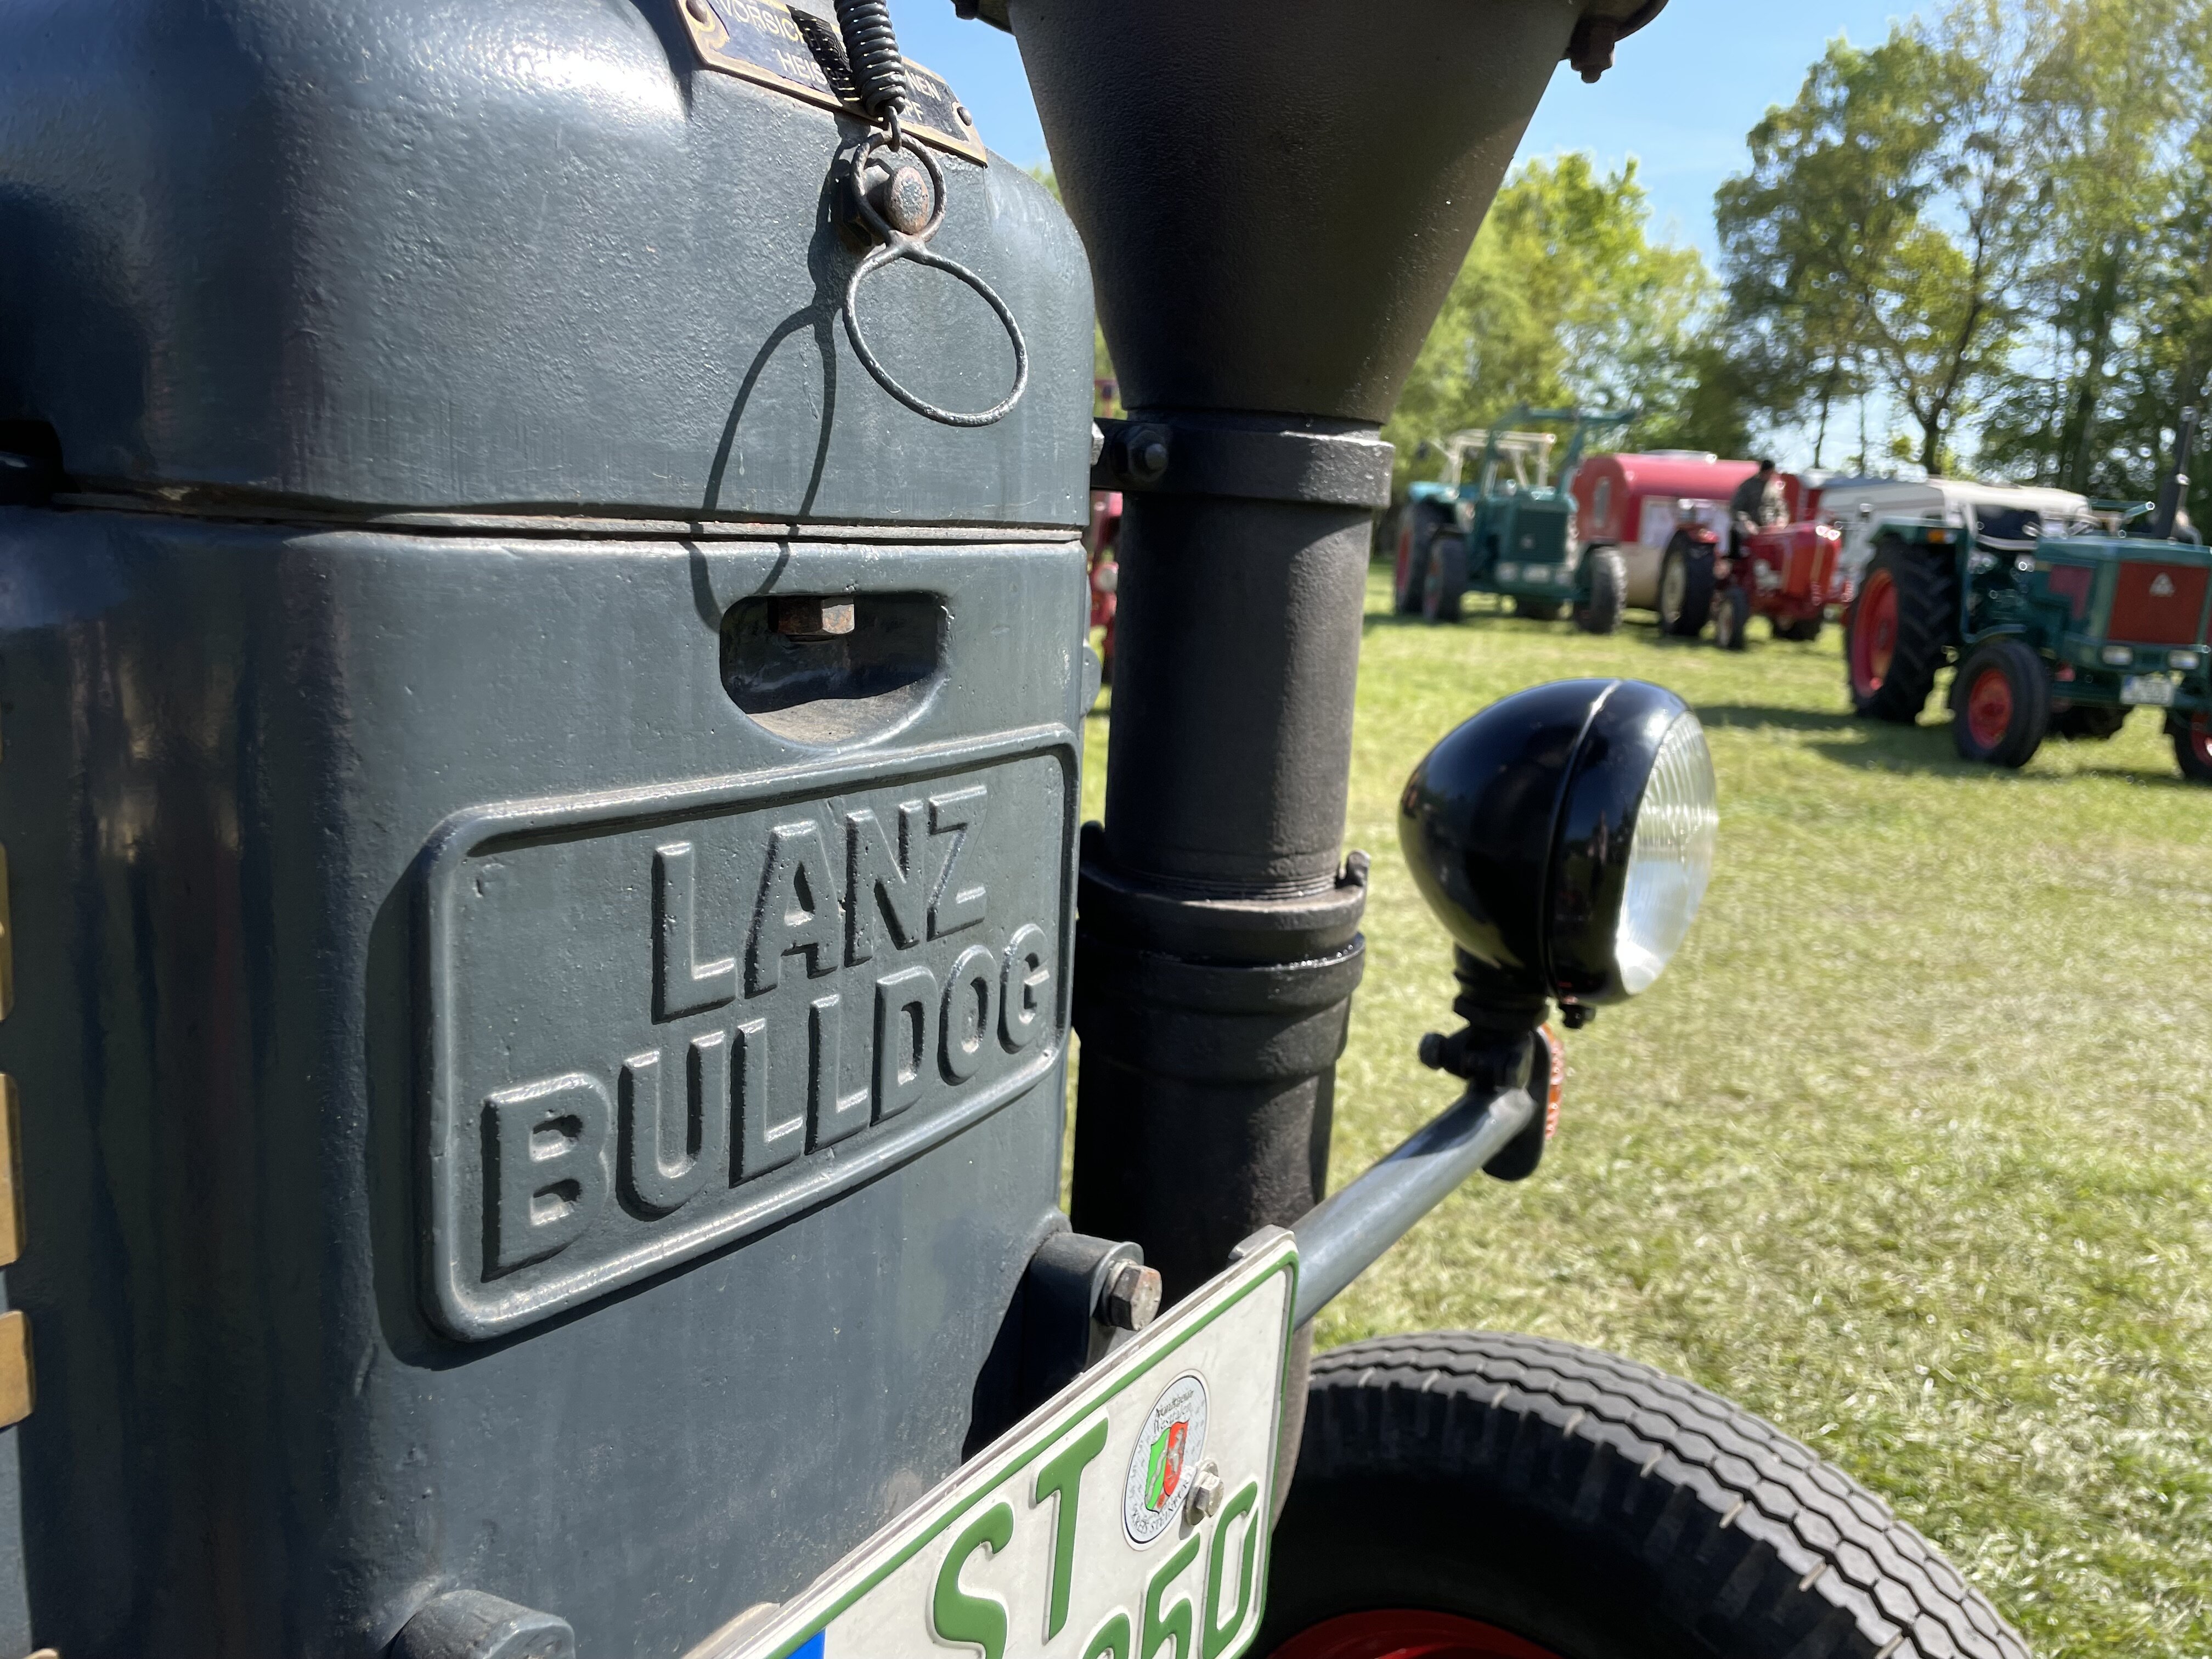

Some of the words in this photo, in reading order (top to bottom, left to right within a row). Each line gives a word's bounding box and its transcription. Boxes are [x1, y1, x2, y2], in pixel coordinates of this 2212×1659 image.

[652, 786, 987, 1024] LANZ
[481, 923, 1050, 1282] BULLDOG
[934, 1418, 1108, 1659] ST
